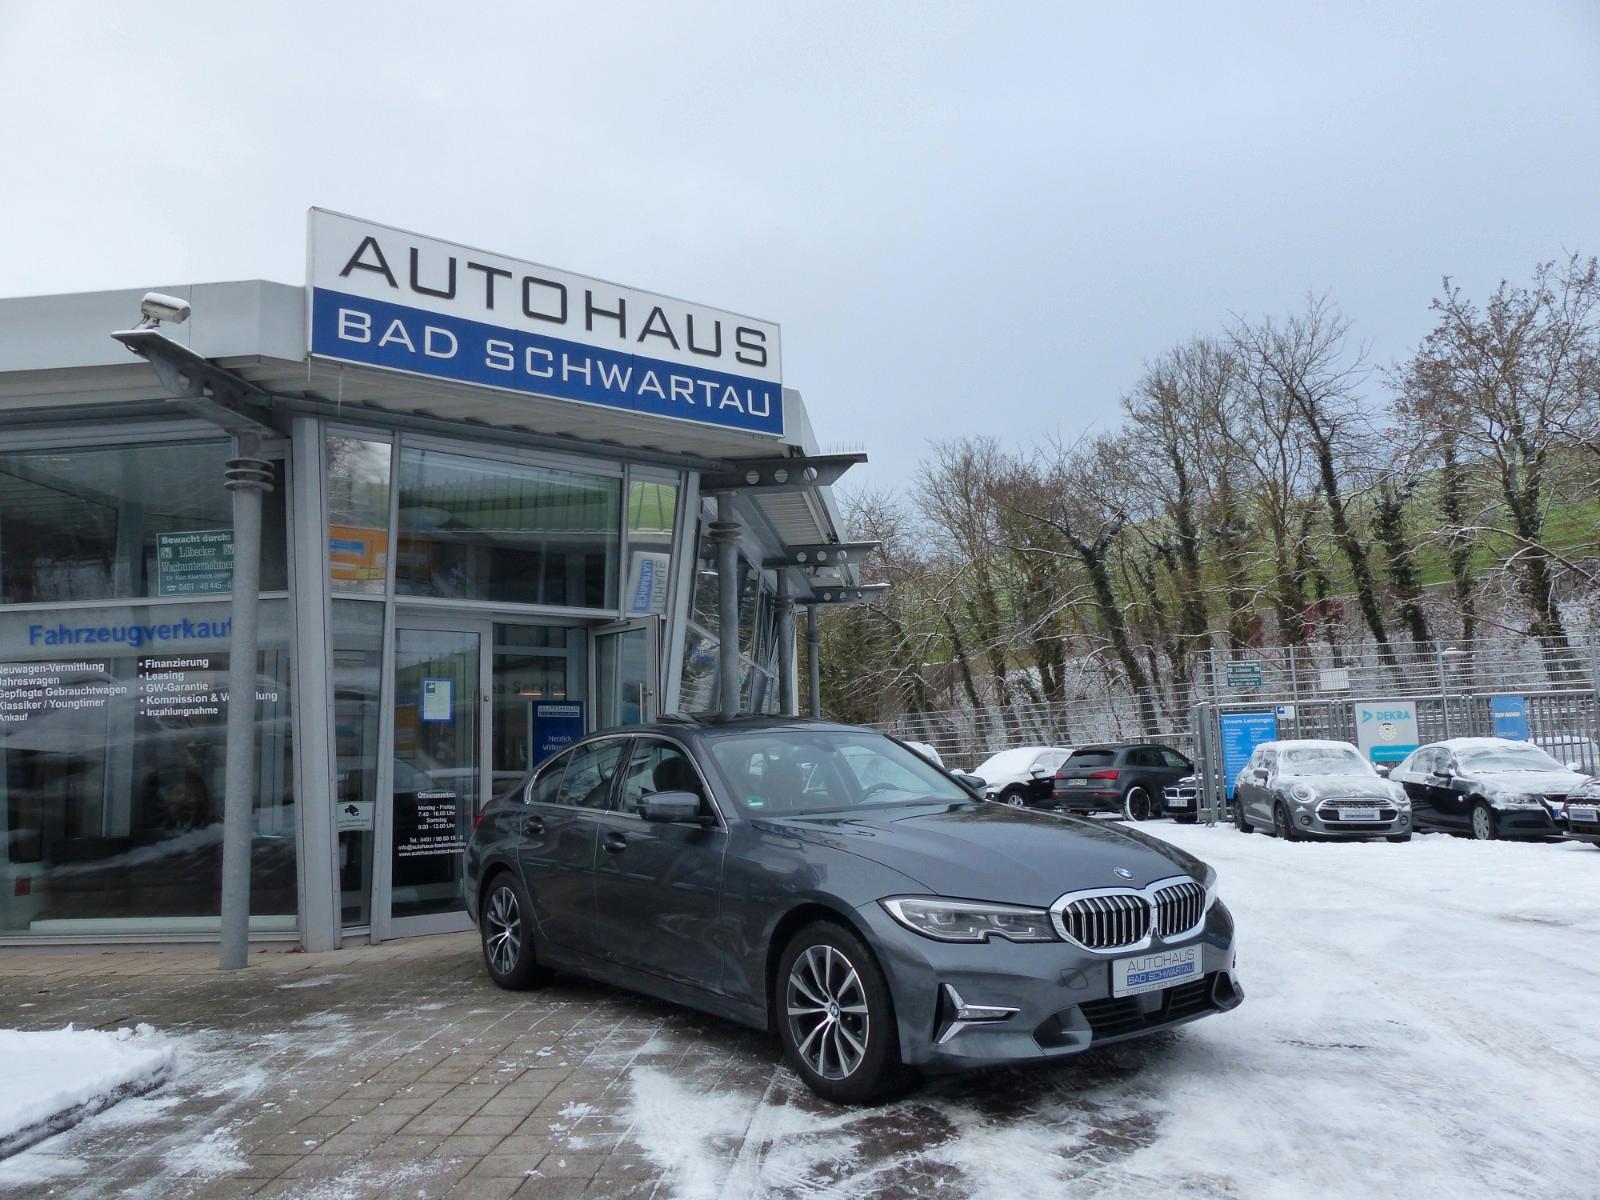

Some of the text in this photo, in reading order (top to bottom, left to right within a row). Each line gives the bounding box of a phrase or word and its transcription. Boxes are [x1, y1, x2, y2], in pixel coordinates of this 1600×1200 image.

[339, 236, 768, 367] AUTOHAUS
[338, 308, 770, 418] BAD SCHWARTAU
[161, 535, 200, 544] Bewacht
[179, 546, 217, 558] Lübecker
[145, 658, 209, 668] Finanzierung
[146, 671, 184, 681] Leasing
[45, 686, 128, 697] Gebrauchtwagen
[146, 681, 209, 692] GW-Garantie
[49, 698, 105, 709] Youngtimer
[146, 694, 208, 704] Kommission
[210, 693, 218, 702] &
[147, 706, 219, 716] Inzahlungnahme
[1376, 711, 1410, 720] DEKRA
[1127, 948, 1195, 973] AUTOHAUS
[1128, 963, 1194, 985] BAD SCHWARTAU
